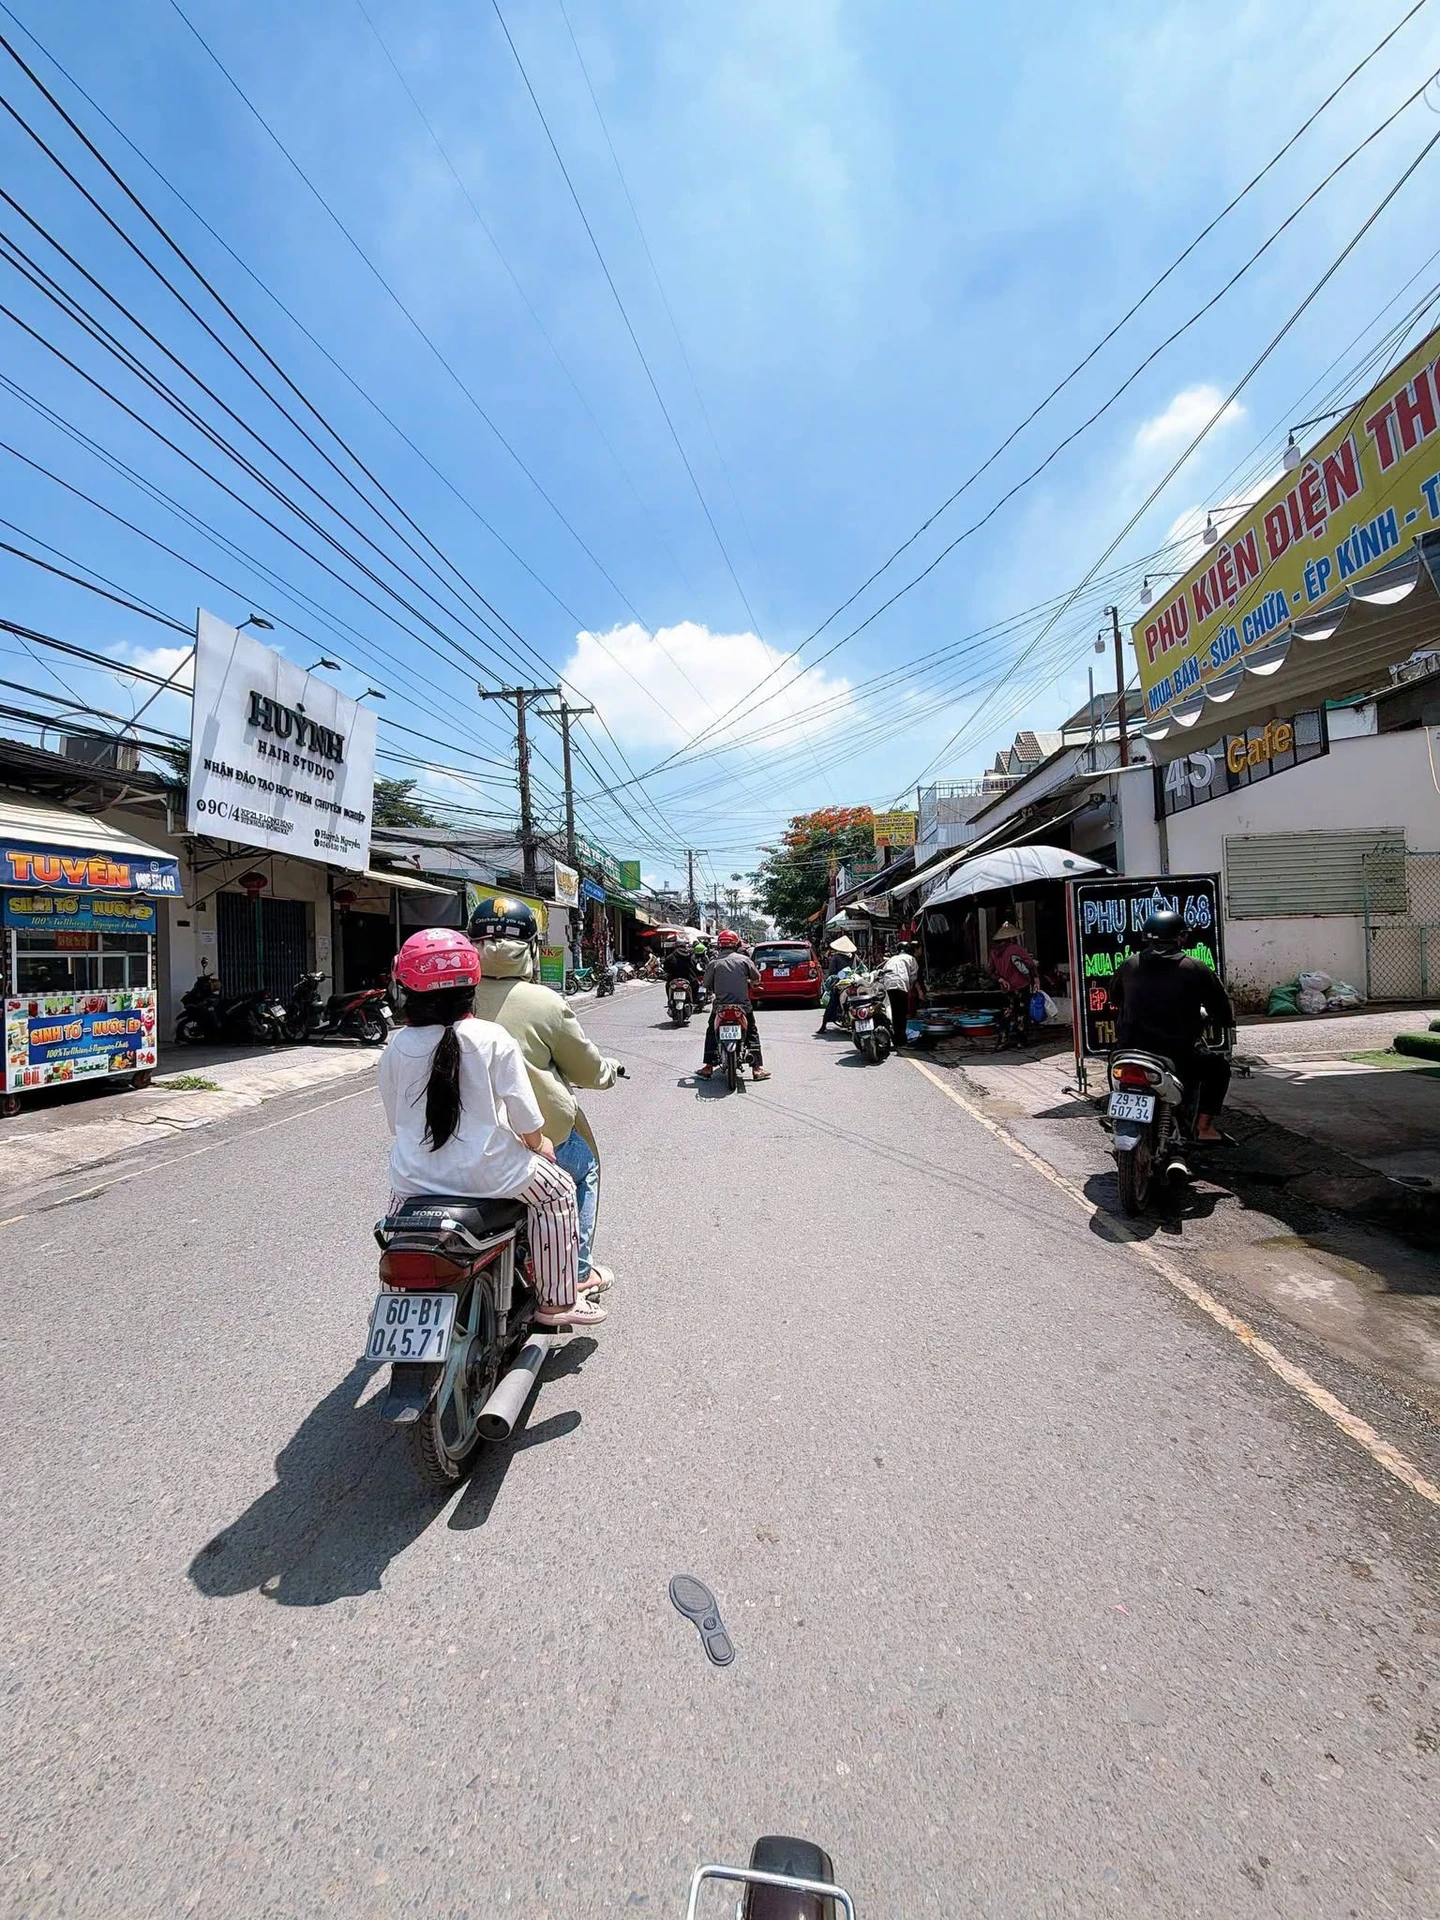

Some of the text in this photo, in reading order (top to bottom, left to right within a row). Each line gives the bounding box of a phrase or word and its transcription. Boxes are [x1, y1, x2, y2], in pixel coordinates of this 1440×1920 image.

[1144, 357, 1440, 665] PHỤ KIỆN ĐIỆN TH
[1147, 676, 1173, 713] MUA
[1173, 656, 1200, 694] BÁN
[1209, 624, 1241, 668] SỬA
[1241, 588, 1290, 646] CHỮA
[1303, 556, 1331, 603] ÉP
[1335, 506, 1400, 581] KÍNH
[248, 690, 345, 764] HUỲNH
[258, 740, 334, 780] HAIR STUDIO
[1227, 719, 1293, 773] Cafe
[204, 758, 234, 777] NHẬN
[258, 777, 274, 791] TẠO
[275, 784, 293, 798] HỌC
[207, 799, 240, 822] 9C/4
[54, 895, 79, 914] TỐ
[1083, 899, 1126, 943] PHỤ
[1183, 894, 1211, 929] 68
[1085, 952, 1114, 977] MUA
[1089, 981, 1107, 1011] ÉP
[30, 1025, 63, 1046] SINH
[64, 1019, 83, 1040] TỐ
[126, 1017, 141, 1034] ÉP
[1110, 1104, 1149, 1120] 507.34
[1116, 1093, 1148, 1107] 29-X5
[412, 1210, 450, 1219] HONDA
[385, 1298, 442, 1325] 60-B1
[371, 1328, 445, 1358] 045.71
